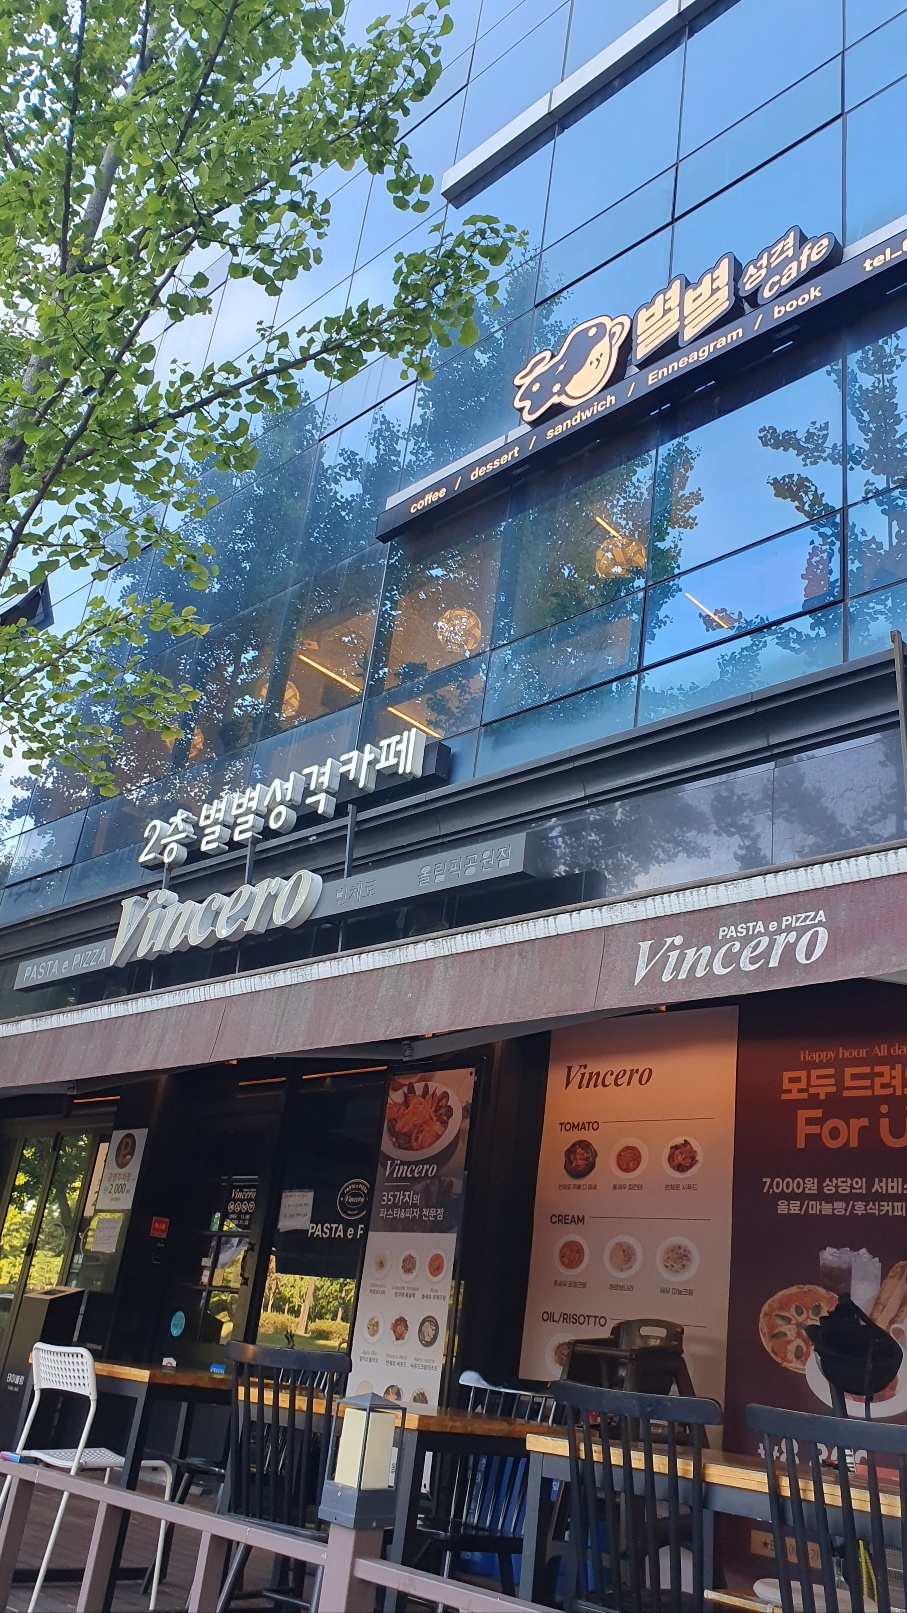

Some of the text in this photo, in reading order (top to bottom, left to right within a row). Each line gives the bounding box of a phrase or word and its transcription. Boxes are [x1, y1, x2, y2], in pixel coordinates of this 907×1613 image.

[742, 229, 797, 291] 성격
[763, 236, 830, 300] cafe
[636, 256, 733, 352] 별별
[409, 484, 447, 515] coffee
[469, 445, 521, 481] dessert
[545, 393, 617, 441] sandwich
[647, 327, 744, 386] Enneagram
[772, 284, 823, 319] book
[110, 870, 321, 968] Vincero
[718, 909, 827, 940] PASTA e PIZZA
[22, 946, 107, 982] PASTA e PIZZA
[633, 926, 829, 986] Vincero
[799, 1049, 837, 1063] Happy
[839, 1046, 870, 1059] hour
[871, 1043, 888, 1057] All
[563, 1063, 653, 1091] Vincero
[780, 1063, 907, 1100] 모두 드려
[558, 1120, 600, 1133] TOMATO
[796, 1108, 870, 1149] For
[384, 1160, 438, 1178] Vincero
[380, 1190, 421, 1206] 35가지의
[762, 1177, 907, 1195] 7,000원 상당의 서비
[379, 1207, 445, 1221] 파스타&피자 전문점
[550, 1213, 585, 1226] CREAM
[308, 1222, 344, 1239] PASTA
[346, 1226, 355, 1239] e
[541, 1310, 608, 1328] OIL/RISOTTO
